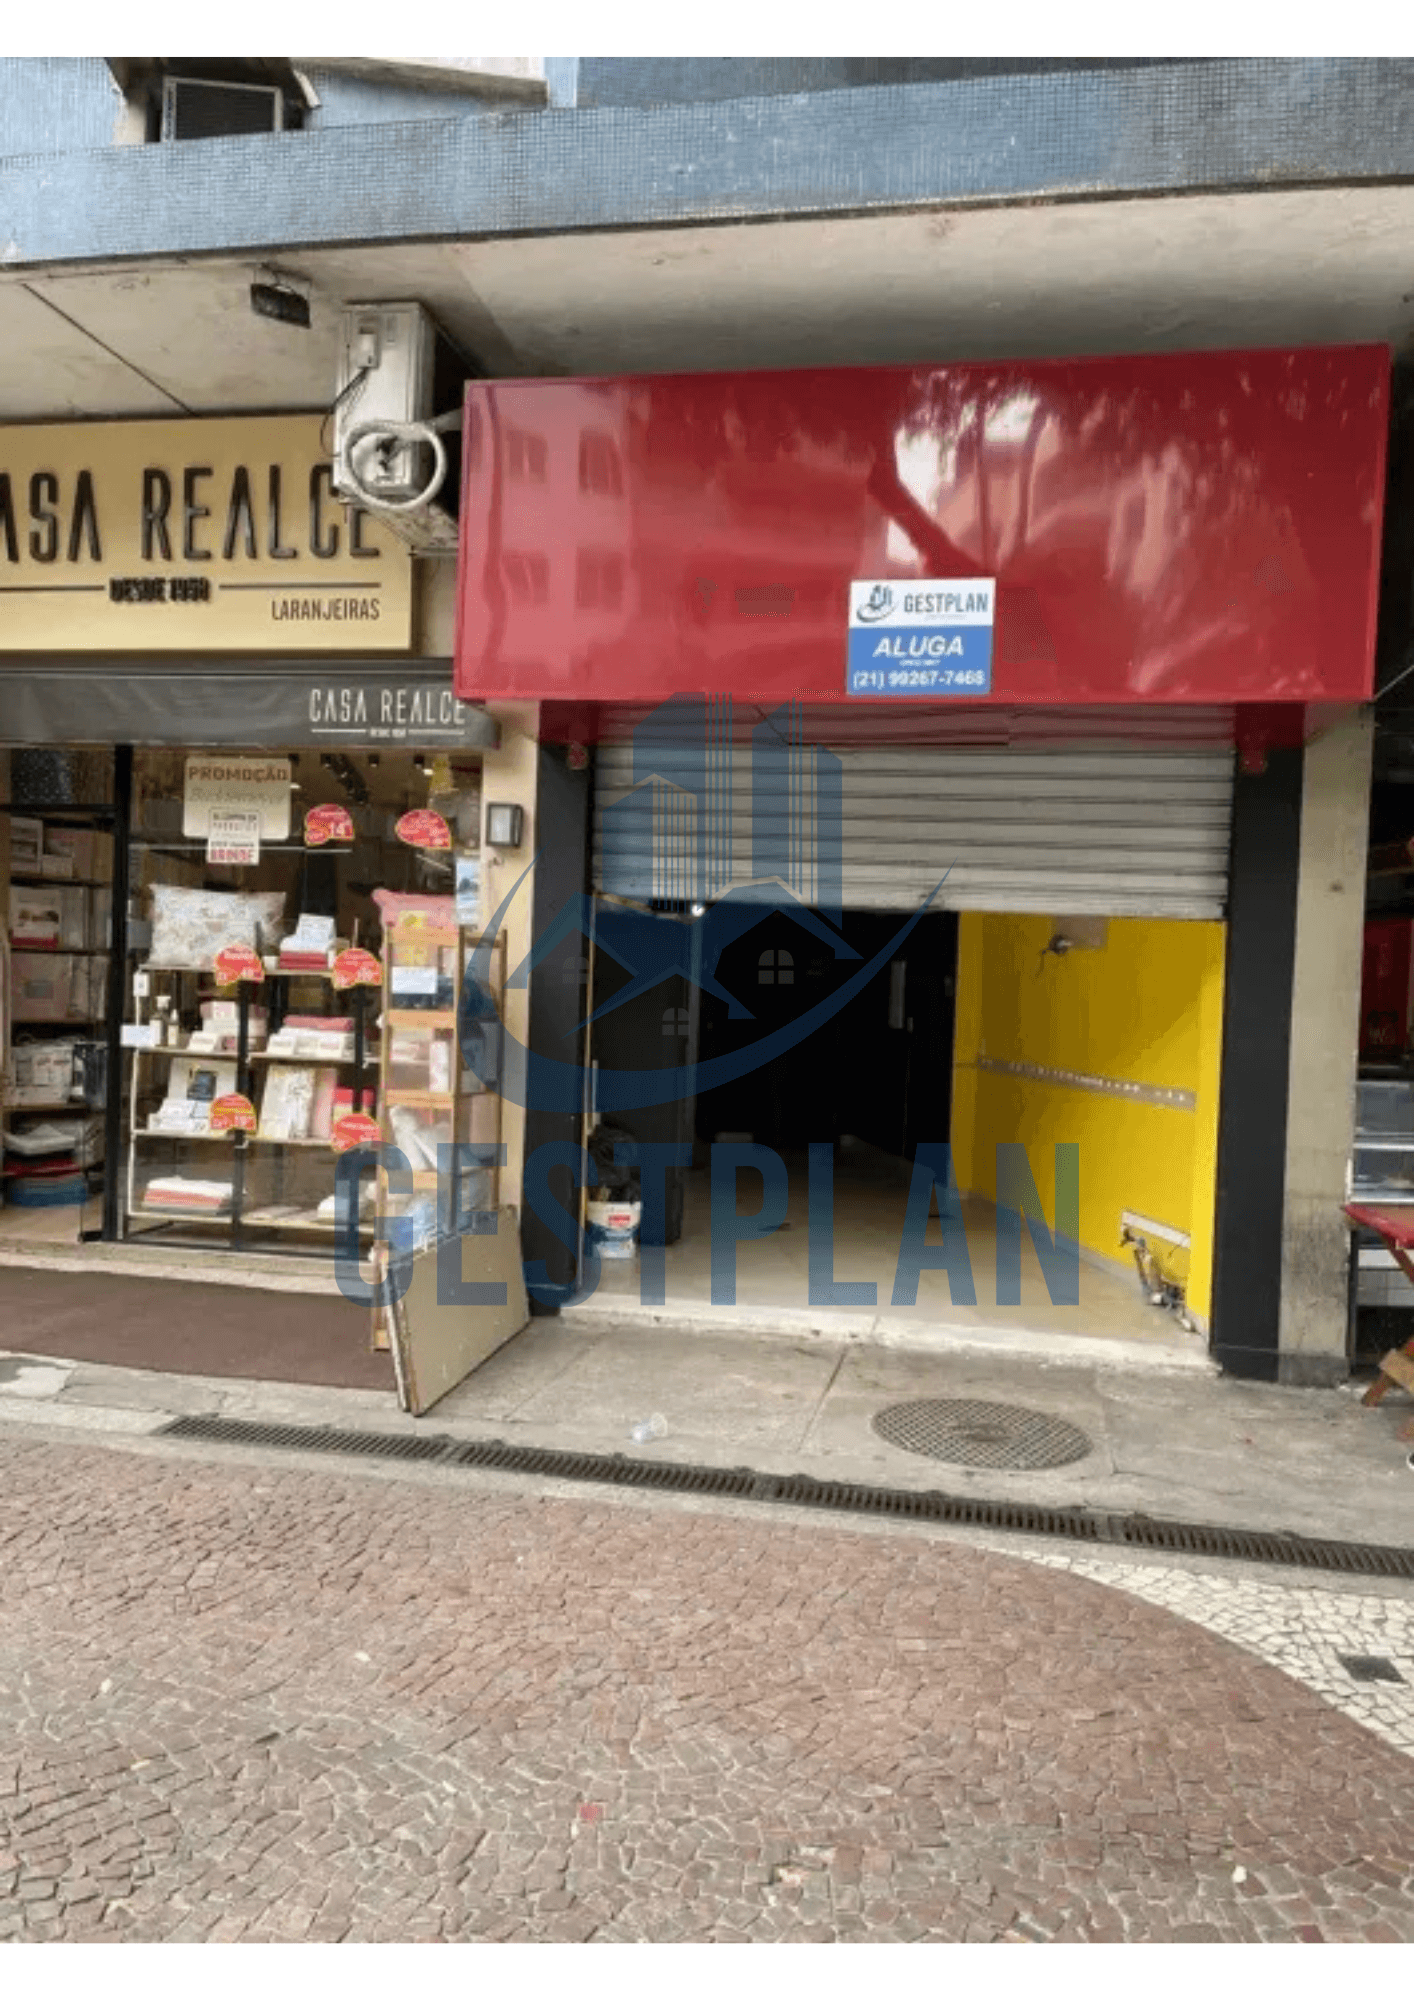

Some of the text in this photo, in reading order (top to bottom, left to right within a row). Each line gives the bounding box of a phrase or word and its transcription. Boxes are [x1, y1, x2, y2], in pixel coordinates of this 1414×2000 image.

[141, 464, 381, 560] REALCE
[271, 598, 381, 621] LARANJEIRAS
[903, 592, 989, 614] GESTPLAN
[871, 635, 965, 658] ALUGA
[853, 669, 886, 691] (21)
[309, 688, 466, 725] CASA REALCE
[188, 764, 288, 784] PROMOÇÃO
